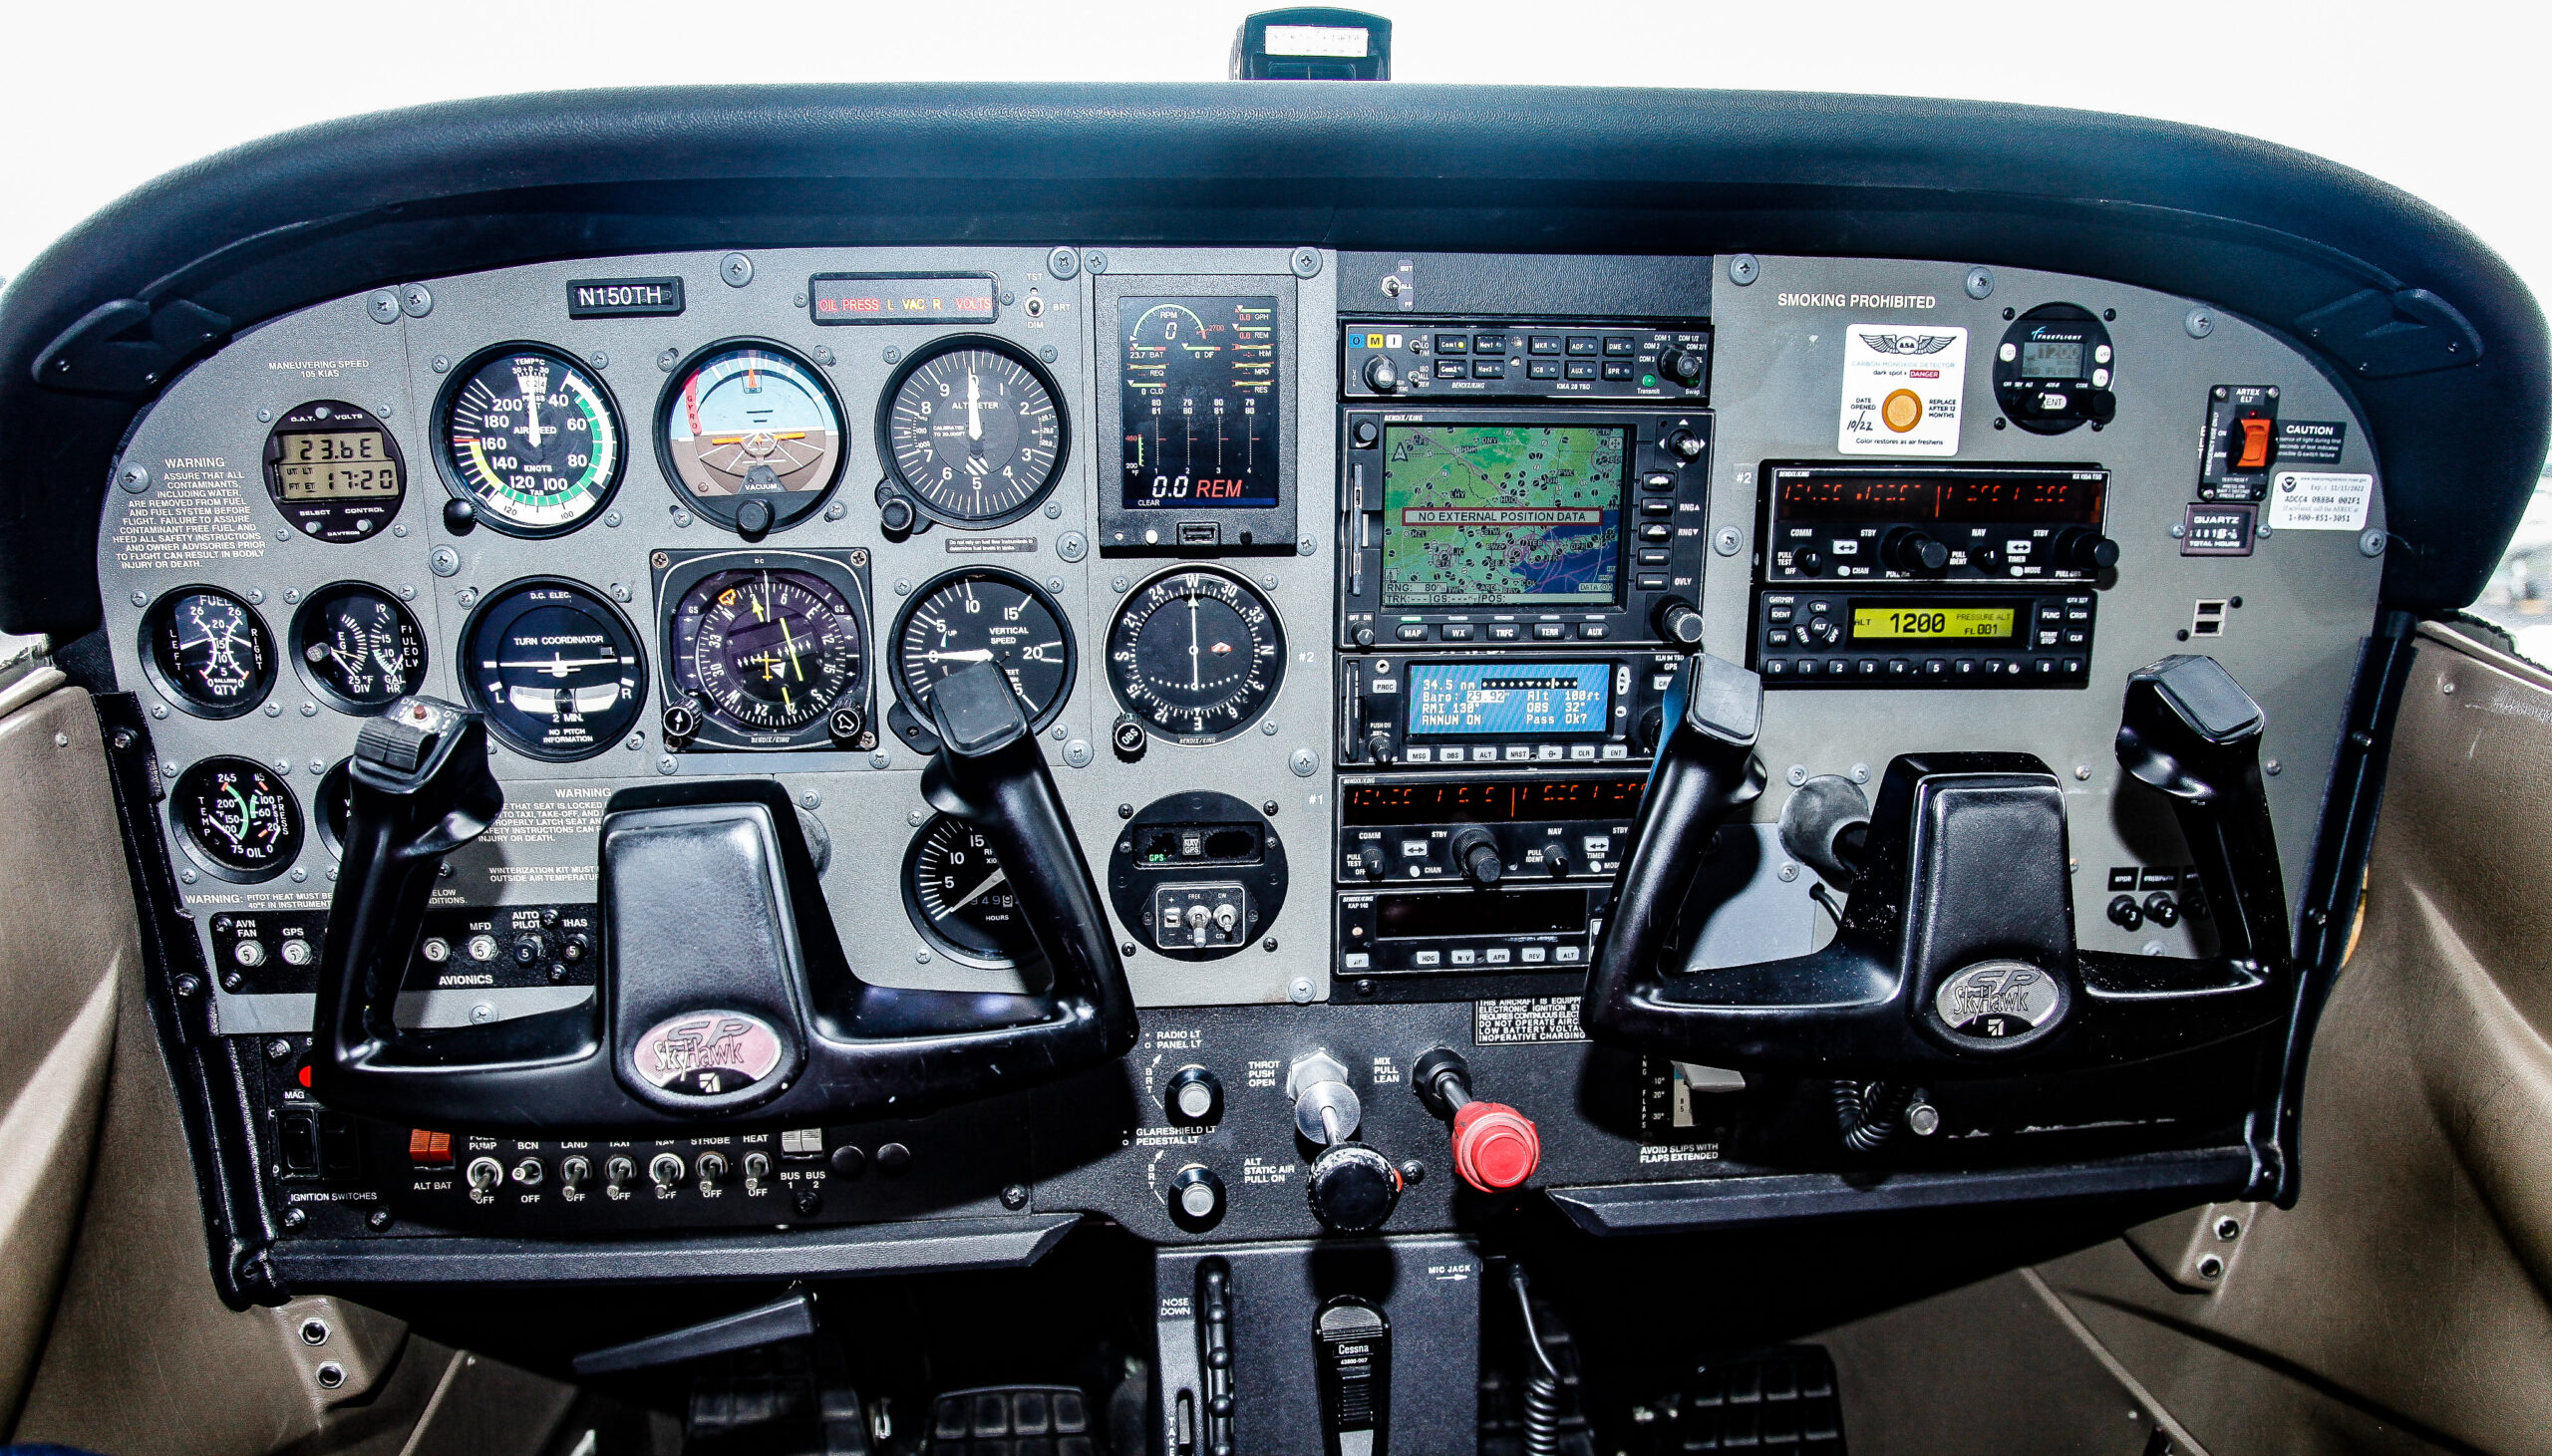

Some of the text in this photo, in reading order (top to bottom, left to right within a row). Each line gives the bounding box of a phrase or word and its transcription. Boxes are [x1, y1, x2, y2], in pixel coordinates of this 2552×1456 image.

[579, 286, 662, 307] N150TH
[1777, 293, 1936, 309] SMOKING PROHIBITED
[818, 299, 838, 312] OIL
[842, 299, 879, 311] PRESS
[902, 299, 925, 310] VAC
[956, 298, 992, 309] VOLTS
[269, 360, 369, 370] MANEUVERING SPEED
[301, 369, 339, 379] 105 KIAS
[491, 398, 521, 412] 200
[547, 394, 569, 408] 40
[483, 415, 509, 429] 180
[567, 418, 587, 431] 60
[1847, 411, 1873, 432] 10/22
[2286, 426, 2334, 436] CAUTION
[481, 437, 506, 450] 160
[164, 457, 224, 468] WARNING
[491, 456, 517, 470] 140
[567, 454, 588, 467] 80
[327, 470, 393, 490] 17:20
[509, 475, 535, 488] 120
[1736, 472, 1752, 484] #2
[543, 477, 567, 490] 100
[744, 482, 778, 491] VACUUM
[1152, 476, 1242, 498] 0.0 REM
[1419, 511, 1585, 521] NO EXTERNAL POSITION DATA
[2194, 515, 2239, 524] QUARTZ
[1675, 577, 1692, 586] OVLY
[199, 595, 232, 607] FUEL
[965, 600, 981, 614] 10
[1004, 607, 1019, 621] 15
[1889, 612, 1945, 633] 1200
[989, 627, 1029, 636] VERTICAL
[1405, 629, 1421, 638] MAP
[1452, 628, 1465, 638] WX
[1496, 628, 1513, 638] TRFC
[1587, 627, 1602, 636] AUX
[541, 635, 603, 644] COORDINATOR
[991, 636, 1017, 645] SPEED
[1023, 646, 1044, 660] 20
[213, 685, 237, 696] QTY
[1423, 680, 1475, 691] 34.5 nm
[1423, 691, 1459, 702] Baro:
[1527, 691, 1549, 701] Alt
[1422, 703, 1447, 713] RMI
[1526, 703, 1549, 713] OBS
[1422, 714, 1481, 726] ANNUN ON
[1526, 714, 1555, 725] Pass
[1120, 727, 1138, 746] OBS
[218, 773, 236, 783] 245
[216, 799, 235, 808] 200
[1548, 827, 1562, 836] NAV
[246, 847, 266, 858] OIL
[185, 895, 243, 904] WARNING:
[511, 912, 539, 922] AUTO
[235, 919, 256, 929] AVN
[470, 921, 491, 931] MFD
[512, 920, 540, 929] PILOT
[237, 928, 257, 938] FAN
[282, 928, 304, 937] GPS
[439, 975, 493, 986] AVIONICS
[1156, 1029, 1200, 1040] RADIO LT
[1156, 1039, 1200, 1049] PANEL LT
[1374, 1056, 1392, 1066] MIX
[1248, 1070, 1275, 1079] PUSH
[1374, 1065, 1399, 1074] PULL
[1248, 1078, 1276, 1087] OPEN
[1374, 1074, 1400, 1083] LEAN
[1136, 1125, 1216, 1137] GLARESHIELD LT
[1136, 1135, 1198, 1146] PEDESTAL LT
[517, 1141, 538, 1151] BCN
[1670, 1144, 1695, 1153] SLIPS
[1244, 1158, 1261, 1167] ALT
[1640, 1152, 1719, 1163] FLAPS EXTENDED
[1244, 1165, 1294, 1176] STATIC AIR
[1271, 1174, 1285, 1183] ON
[413, 1181, 453, 1191] ALT BAT
[291, 1191, 377, 1202] IGNITION SWITCHES
[1448, 1265, 1470, 1274] JACK
[1160, 1307, 1190, 1315] DOWN
[1338, 1343, 1370, 1355] Cessna
